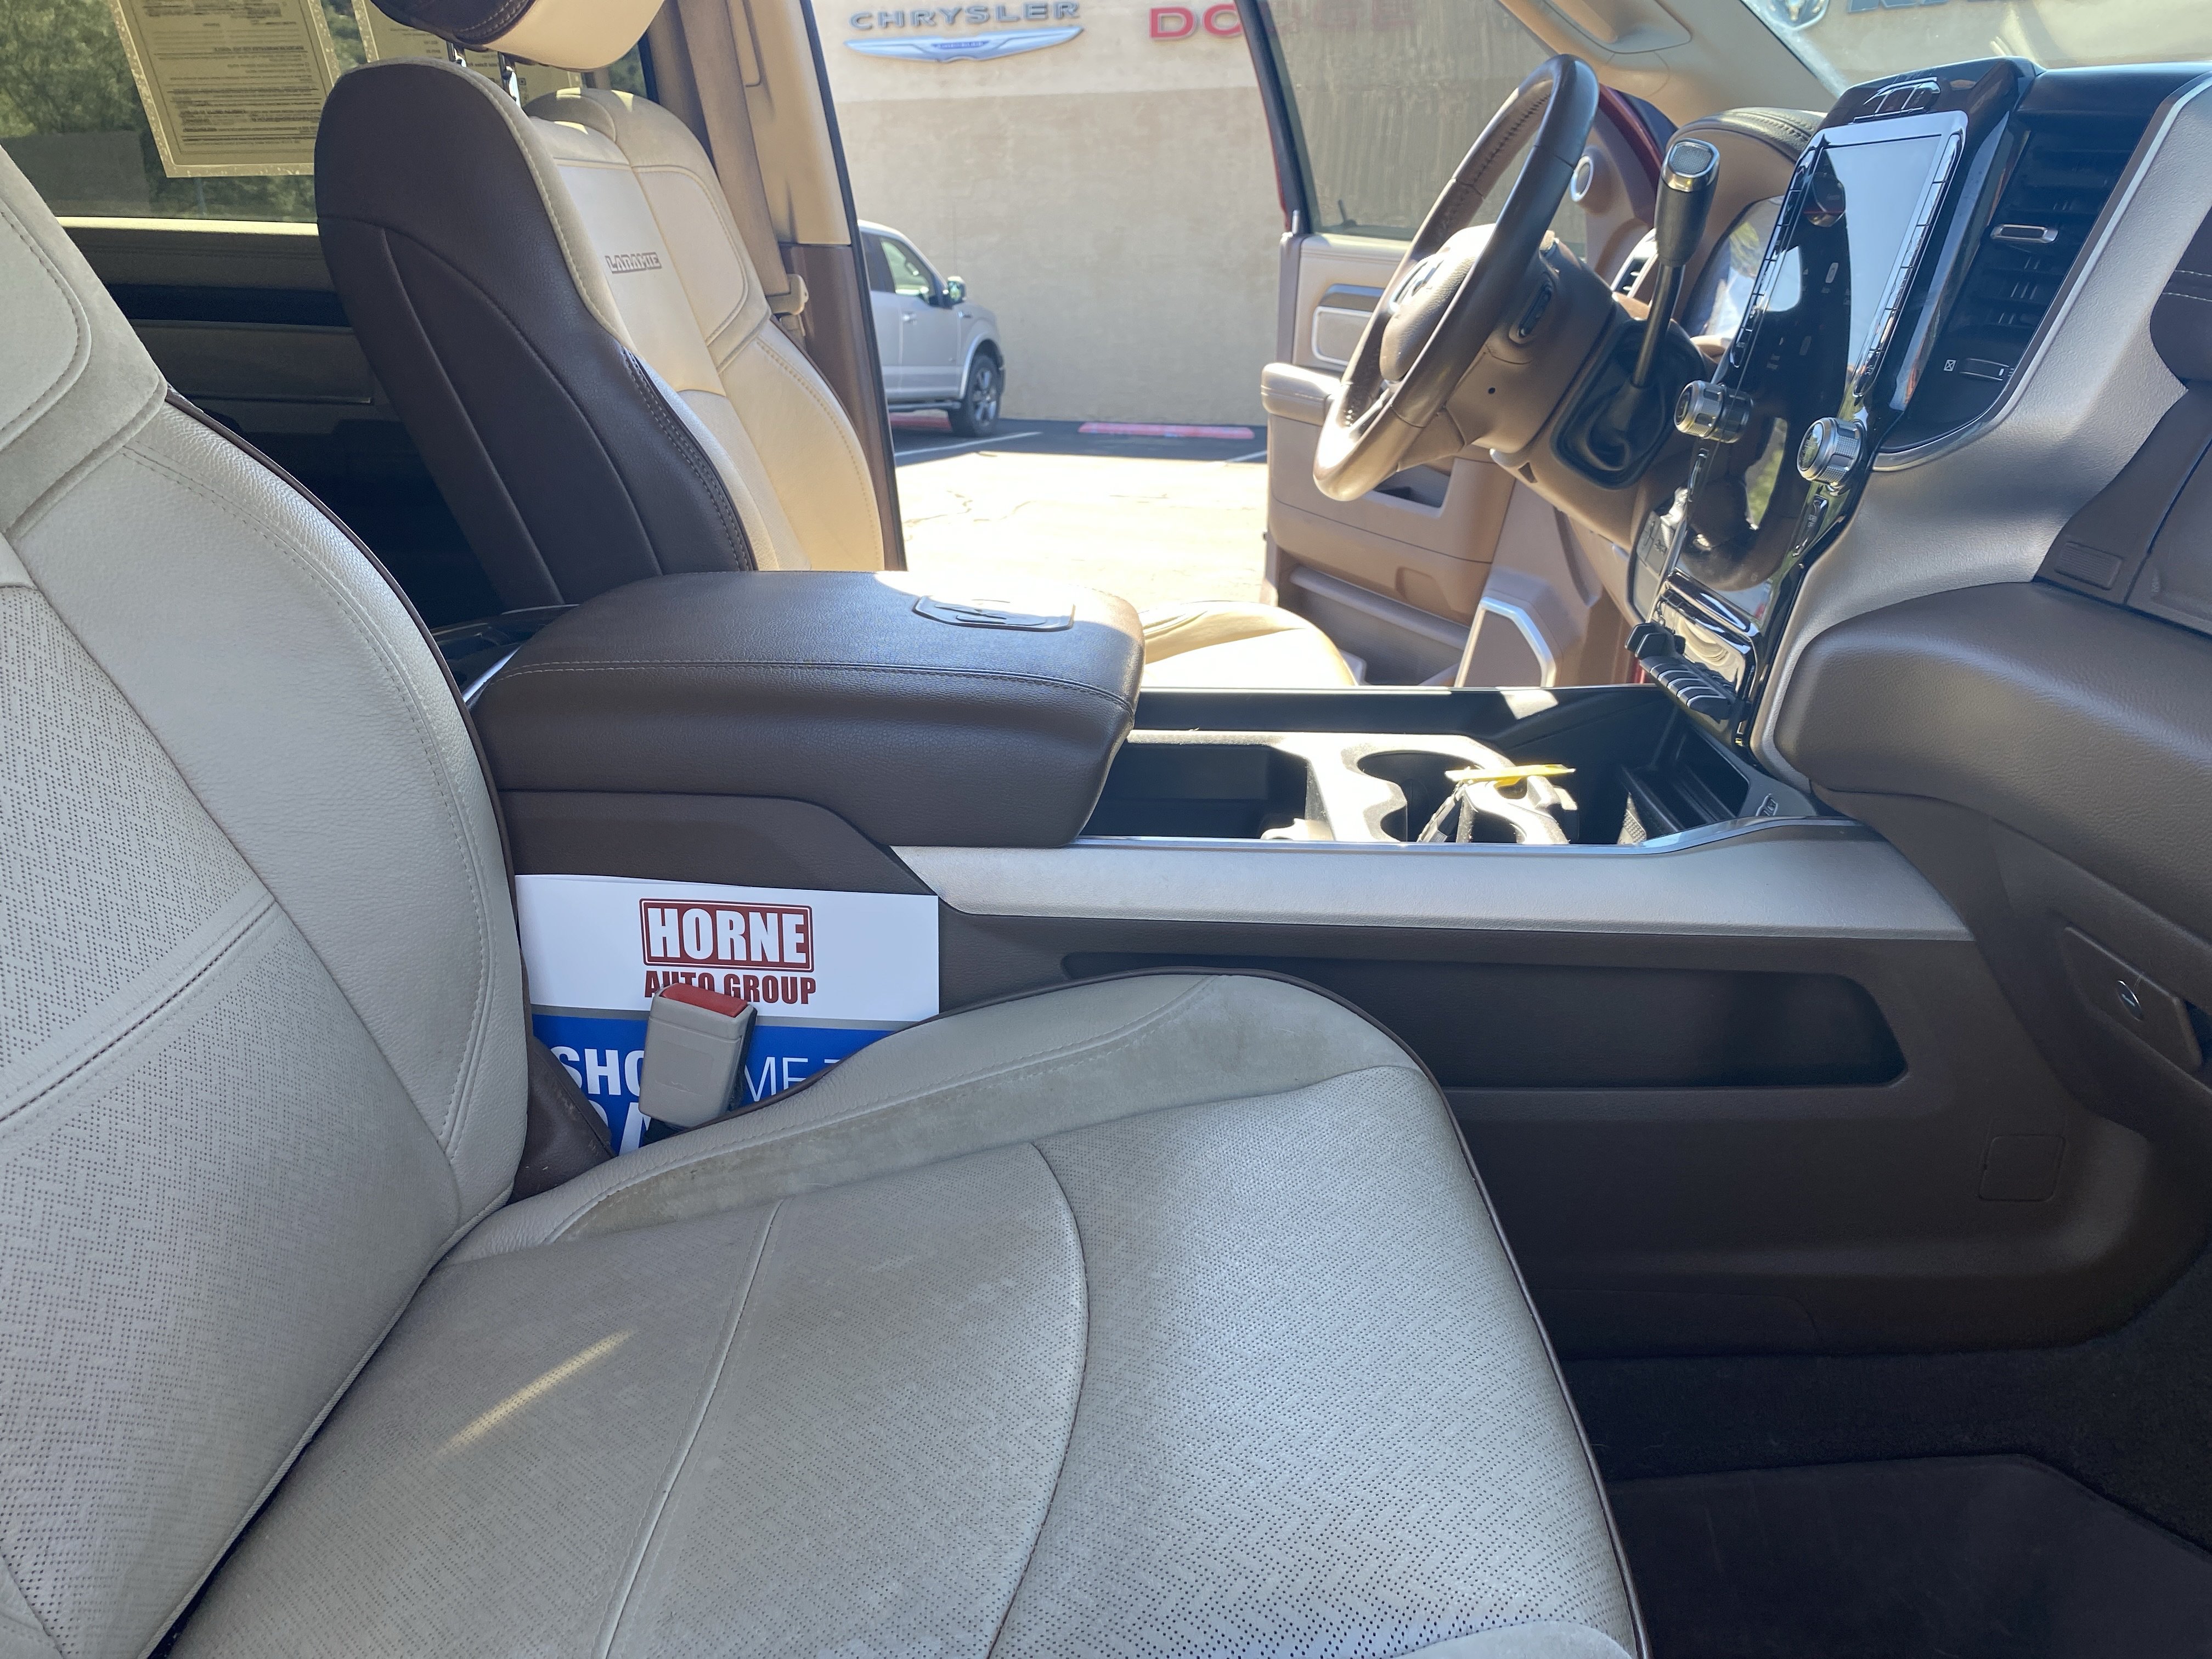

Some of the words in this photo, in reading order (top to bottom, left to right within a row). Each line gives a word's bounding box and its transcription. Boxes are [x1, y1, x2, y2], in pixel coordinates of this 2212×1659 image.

[848, 1, 1080, 30] CHRYSLER
[647, 907, 806, 964] HORNE
[645, 970, 715, 998] AUTO
[724, 974, 816, 1005] GROUP
[550, 1046, 645, 1096] SHO
